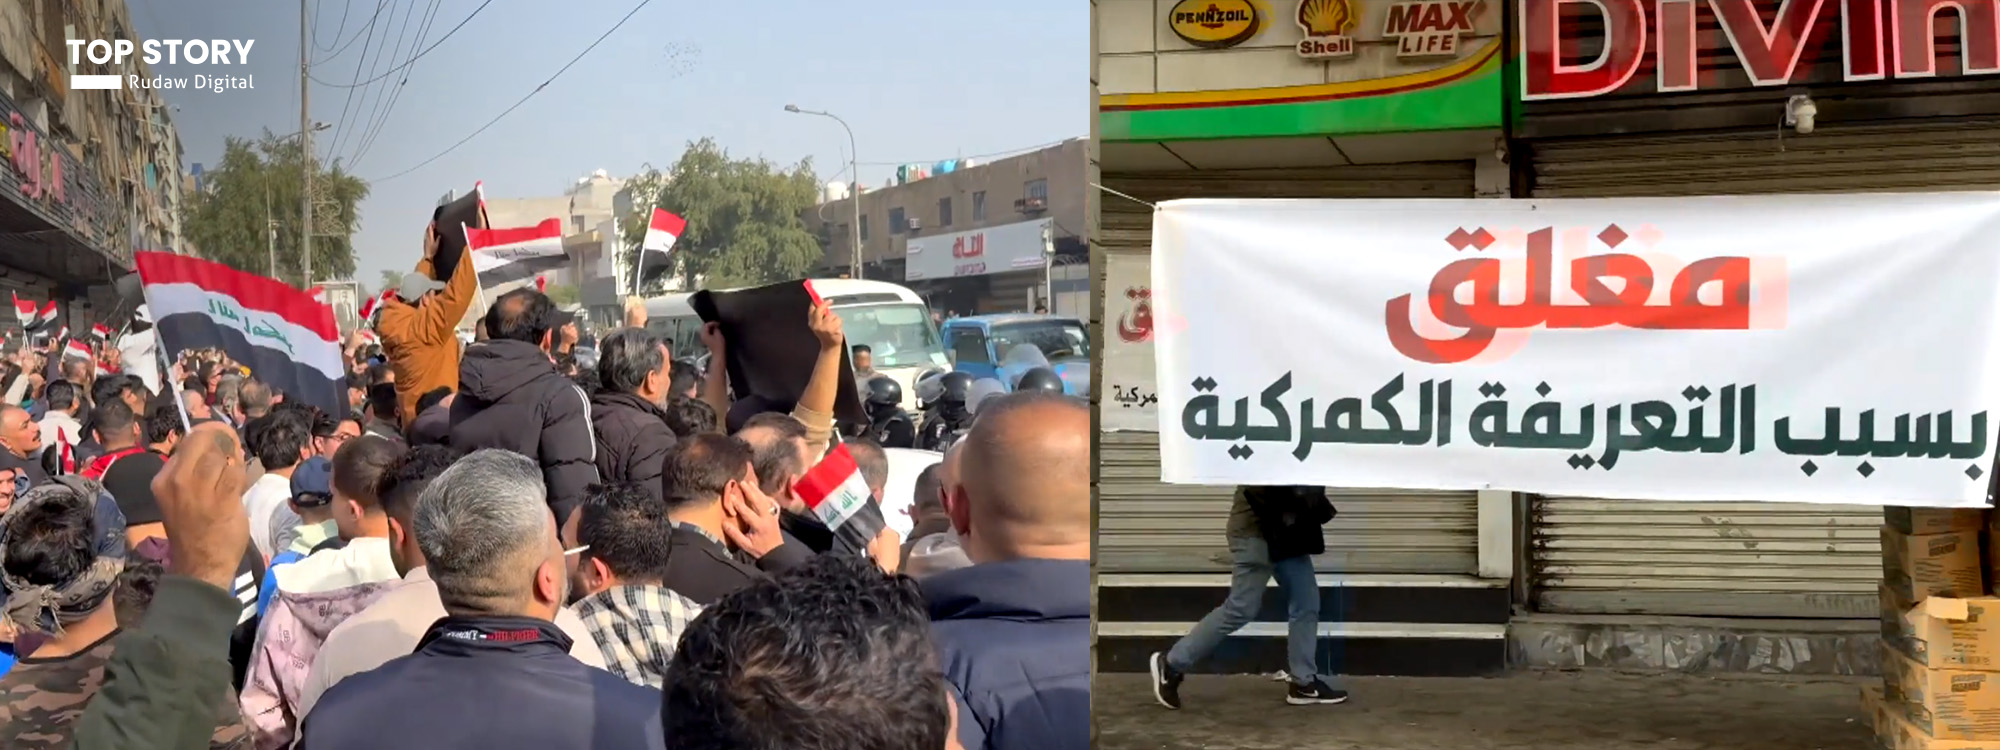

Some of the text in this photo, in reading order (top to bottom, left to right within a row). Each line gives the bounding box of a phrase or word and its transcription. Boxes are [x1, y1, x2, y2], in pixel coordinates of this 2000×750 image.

[1175, 9, 1249, 24] PENNZOIL
[1386, 1, 1475, 34] MAX
[1299, 38, 1351, 54] Shell
[1401, 34, 1454, 54] LIFE
[1385, 223, 1752, 365] مغلق
[1182, 371, 1989, 482] بسبب التعريفة الكمركية
